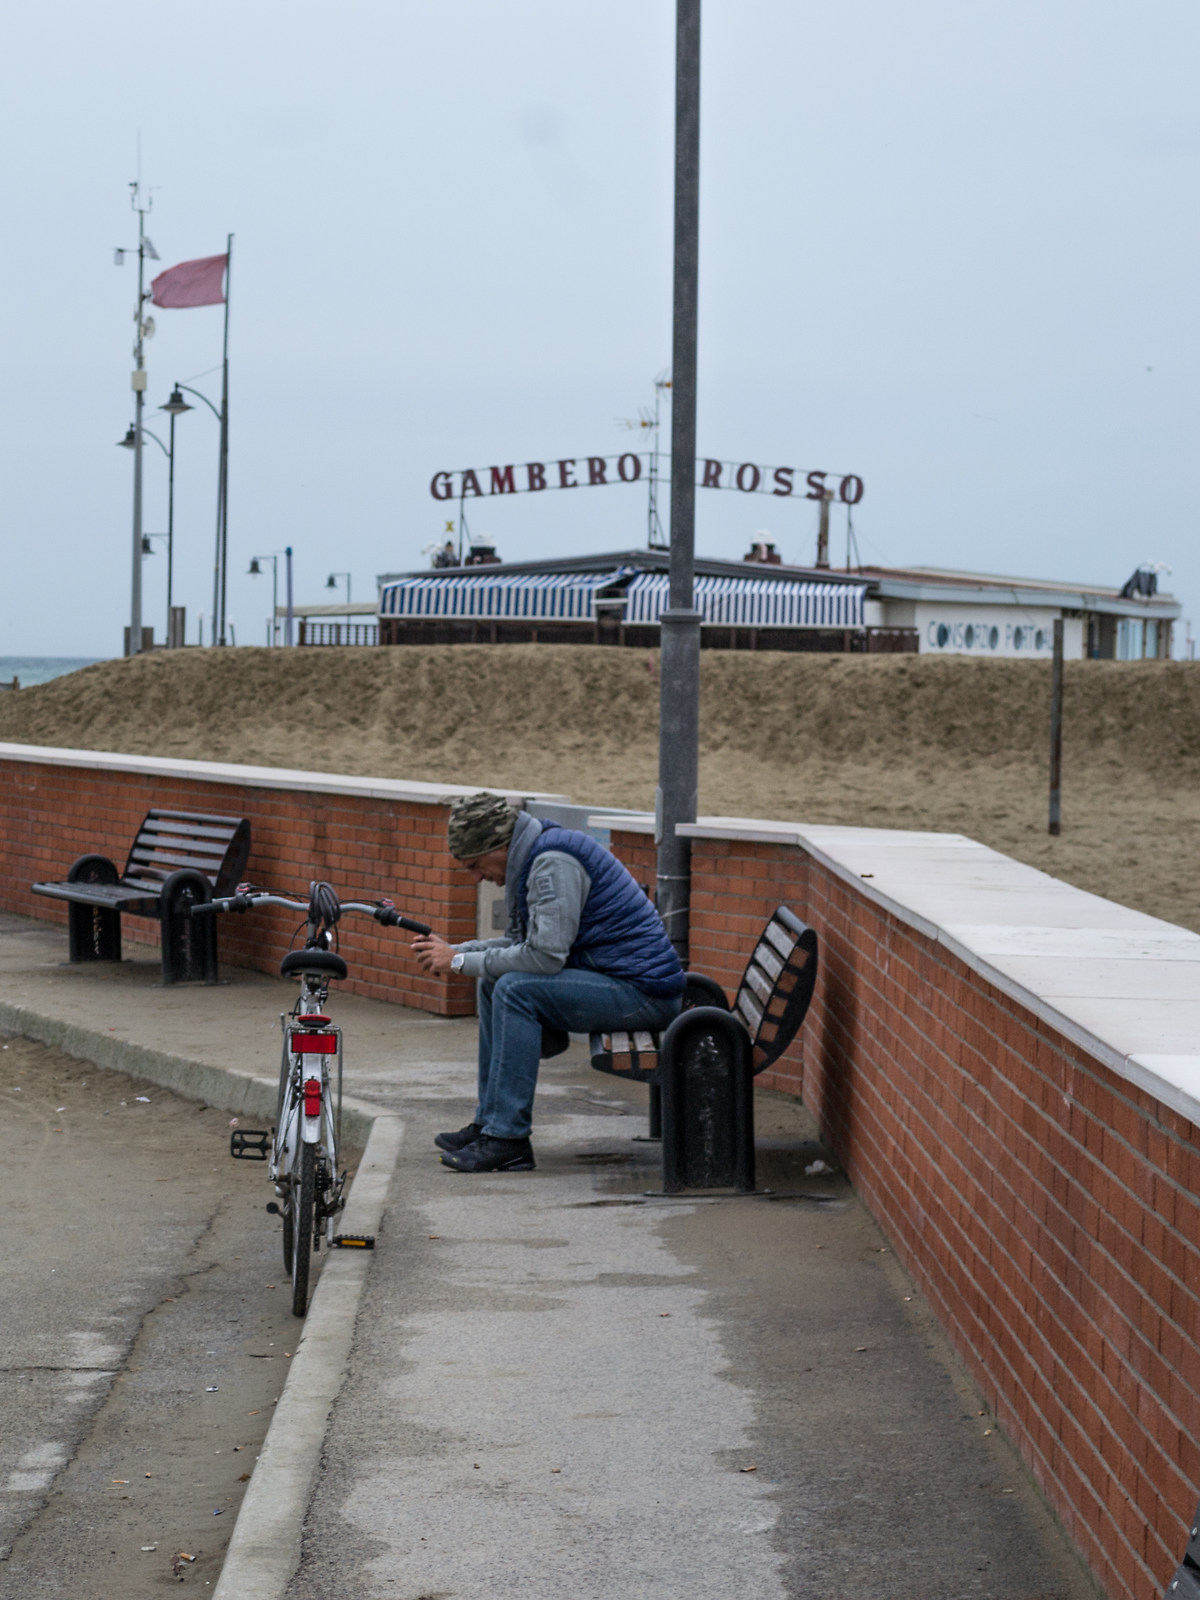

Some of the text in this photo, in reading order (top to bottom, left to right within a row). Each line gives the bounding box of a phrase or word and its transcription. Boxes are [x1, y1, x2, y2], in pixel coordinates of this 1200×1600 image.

[430, 453, 864, 505] GAMBERO ROSSO
[927, 620, 999, 650] CONSORZIO
